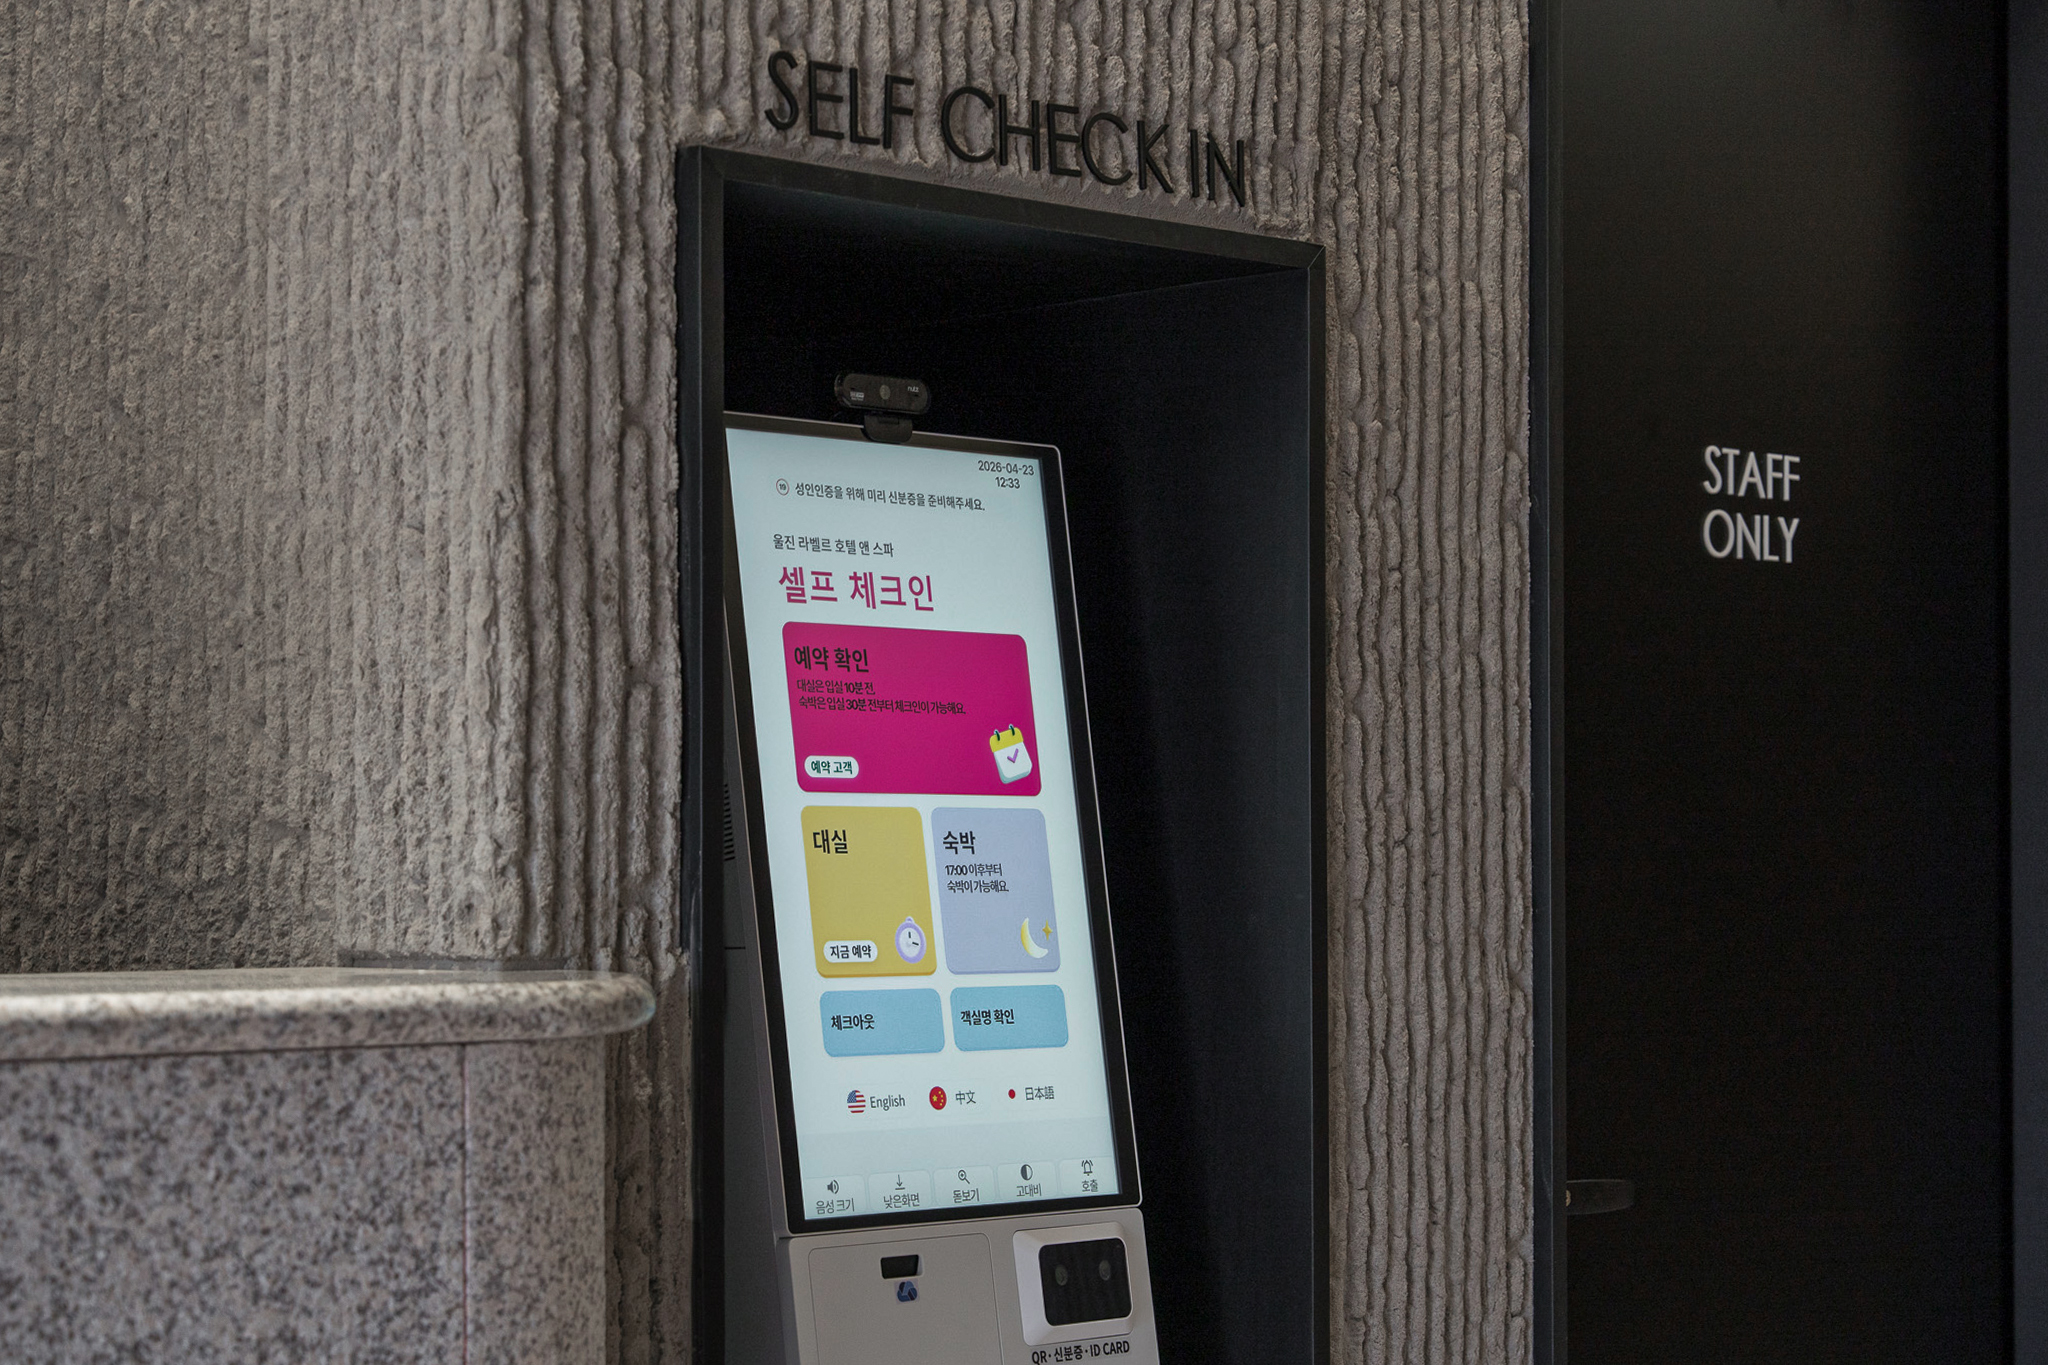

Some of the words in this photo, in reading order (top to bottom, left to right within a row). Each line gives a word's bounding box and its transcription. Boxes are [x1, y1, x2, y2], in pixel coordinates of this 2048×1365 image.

[764, 50, 914, 149] SELF
[941, 86, 1174, 194] CHECK
[1189, 128, 1245, 207] IN
[978, 460, 1035, 476] 2026-04-23
[1703, 445, 1800, 501] STAFF
[995, 476, 1020, 489] 12:33
[795, 482, 843, 500] 성인인증을
[846, 486, 865, 502] 위해
[867, 489, 886, 503] 미리
[888, 491, 926, 507] 신분증을
[927, 494, 986, 511] 준비해주세요.
[773, 533, 796, 550] 울진
[798, 536, 832, 553] 라벨르
[834, 539, 857, 555] 호텔
[858, 540, 870, 556] 앤
[873, 542, 894, 557] 스파
[1703, 509, 1799, 564] ONLY
[778, 566, 838, 604] 셀프
[849, 571, 934, 612] 체크인
[794, 646, 829, 671] 예약
[833, 647, 869, 673] 확인
[796, 678, 825, 693] 대실은
[825, 680, 844, 694] 입실
[844, 681, 864, 695] 10분
[798, 695, 826, 710] 숙박은
[826, 697, 845, 711] 입실
[845, 698, 867, 712] 30분
[868, 698, 894, 713] 전부터
[895, 700, 930, 714] 체크인이
[811, 760, 831, 774] 예약
[833, 761, 853, 775] 고객
[812, 829, 849, 854] 대실
[942, 831, 976, 855] 숙박
[947, 879, 973, 894] 숙박이
[830, 945, 850, 959] 지금
[852, 944, 872, 958] 예약
[831, 1013, 875, 1030] 체크아웃
[960, 1010, 991, 1026] 객실명
[993, 1008, 1015, 1025] 확인
[955, 1089, 977, 1105] 中文
[1025, 1086, 1055, 1101] 日本語
[870, 1094, 906, 1111] English
[1016, 1182, 1042, 1197] 고대비
[1081, 1179, 1099, 1193] 호출
[952, 1188, 980, 1204] 돋보기
[816, 1199, 835, 1215] 음성
[836, 1198, 855, 1212] 크기
[1102, 1340, 1130, 1356] CARD
